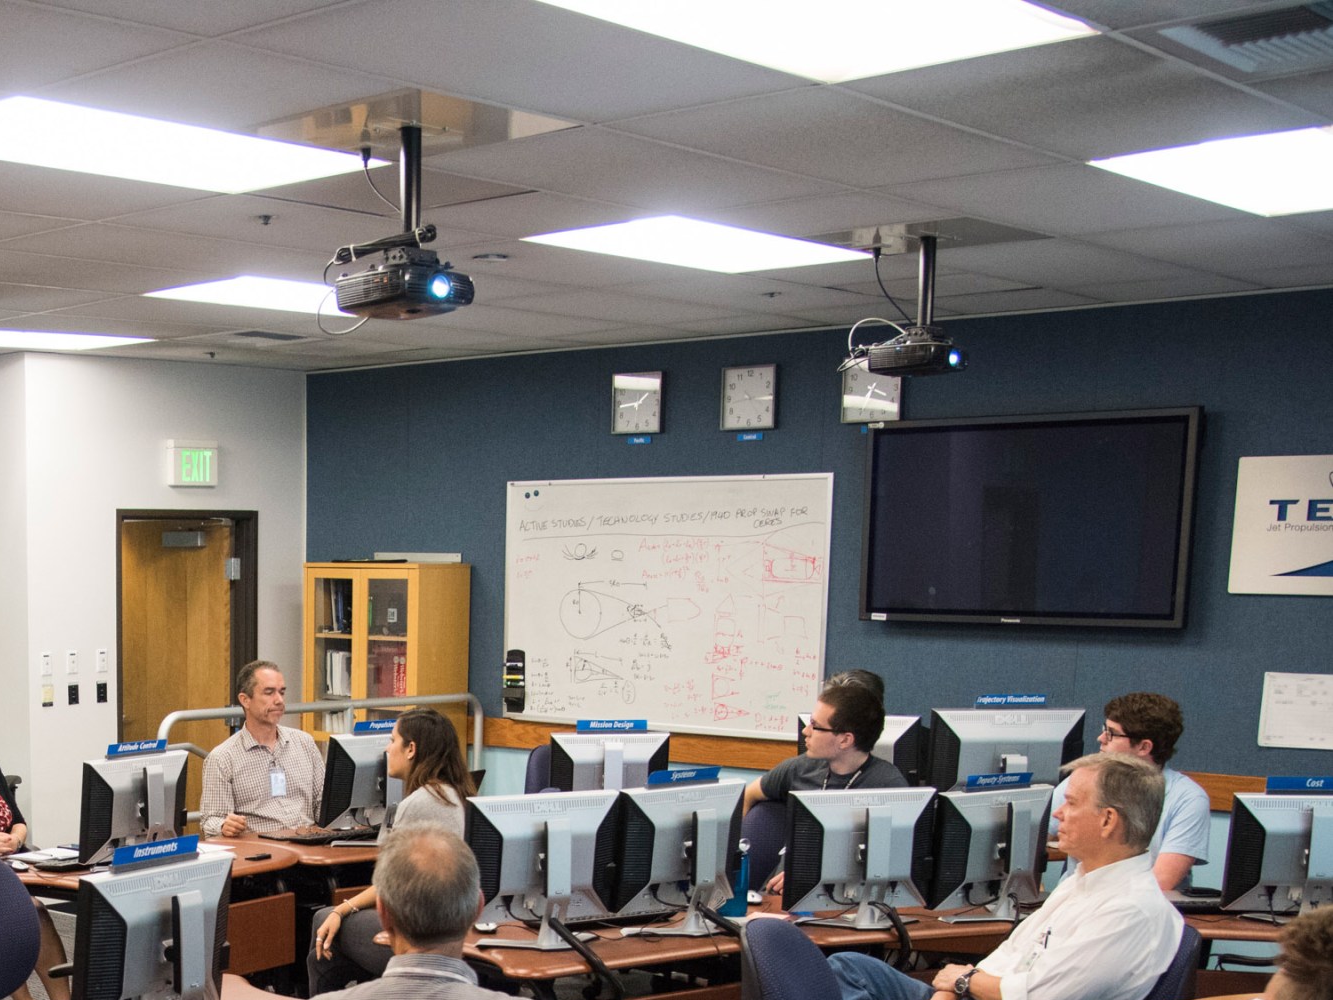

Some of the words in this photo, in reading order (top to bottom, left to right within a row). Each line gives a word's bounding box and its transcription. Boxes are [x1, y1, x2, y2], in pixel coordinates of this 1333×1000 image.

[737, 373, 743, 381] 11
[747, 369, 754, 377] 12
[181, 450, 212, 482] EXIT
[519, 519, 548, 531] ACTIVE
[790, 506, 808, 516] FOR
[1266, 523, 1282, 531] Jet
[1006, 695, 1045, 703] Visualization
[613, 720, 634, 730] Design
[118, 742, 140, 752] Attitude
[139, 740, 159, 750] Control
[977, 776, 997, 785] Deputy
[997, 775, 1021, 784] Systems
[1306, 778, 1324, 787] Cost
[133, 842, 178, 858] Instruments
